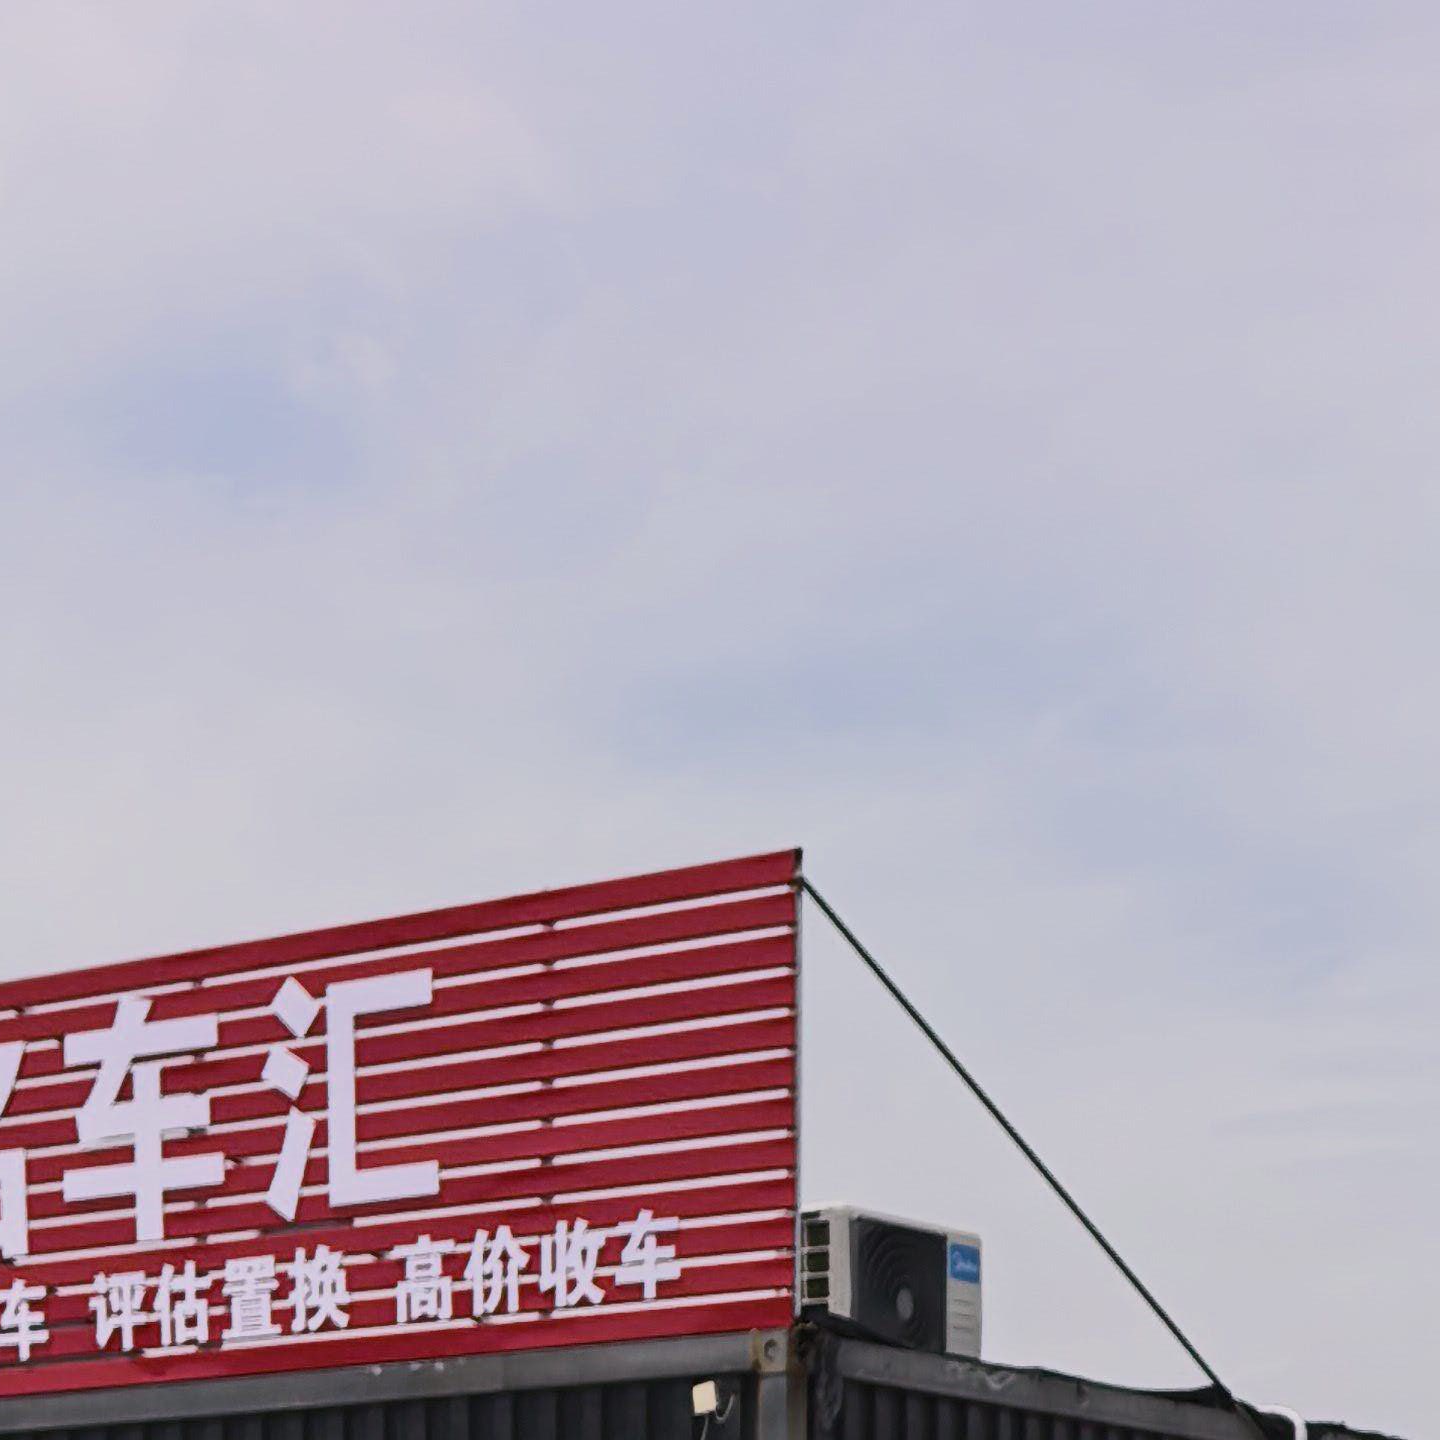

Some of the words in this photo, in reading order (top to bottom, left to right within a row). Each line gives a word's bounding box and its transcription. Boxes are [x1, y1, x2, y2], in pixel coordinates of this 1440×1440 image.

[88, 1243, 352, 1352] 评估置换
[385, 1208, 683, 1325] 高价收车
